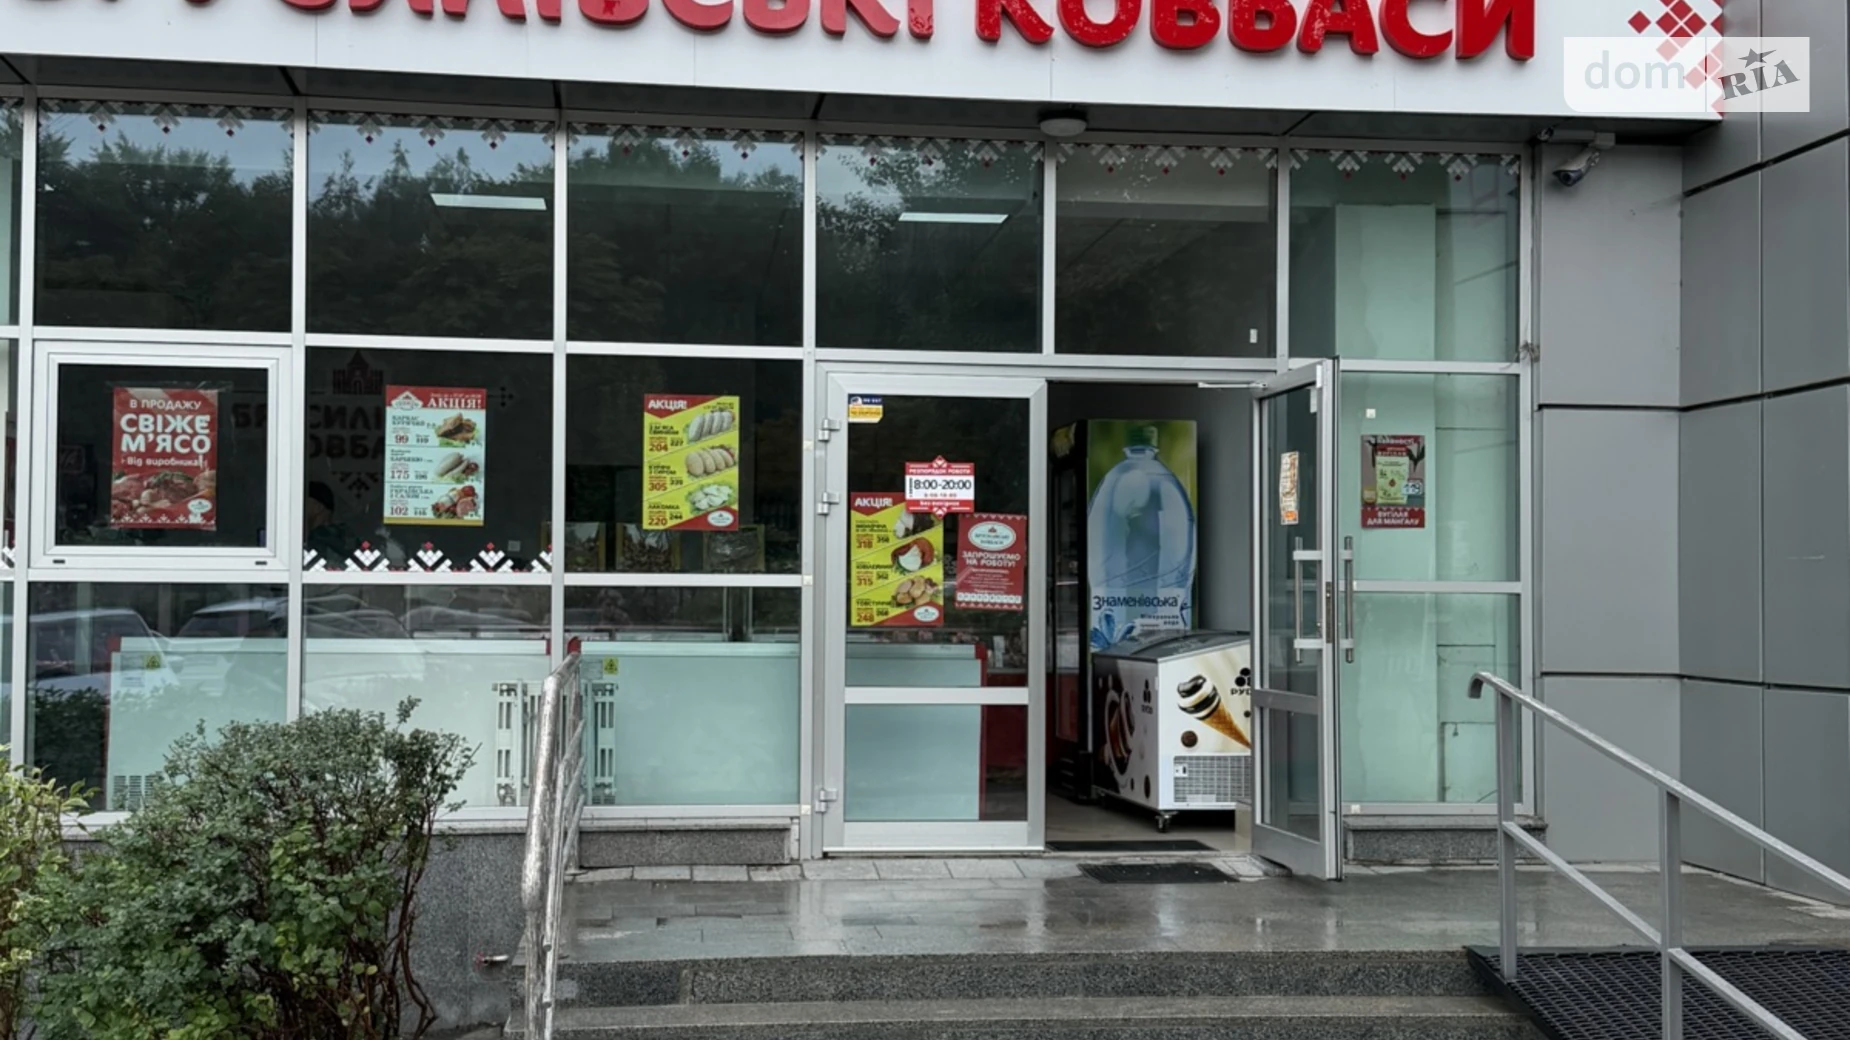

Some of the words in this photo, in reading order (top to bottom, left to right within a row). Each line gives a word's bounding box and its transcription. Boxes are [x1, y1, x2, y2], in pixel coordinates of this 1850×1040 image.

[129, 399, 137, 409] В
[141, 399, 201, 410] ПРОДАЖУ
[427, 397, 481, 409] АКЦІЯ!
[648, 399, 688, 411] АКЦІЯ!
[120, 413, 211, 434] СВІЖЕ
[120, 433, 212, 454] М’ЯСО
[394, 434, 409, 444] 99
[648, 442, 669, 452] 204
[390, 470, 410, 480] 175
[648, 482, 668, 491] 305
[913, 479, 972, 490] 8:00-20:00
[854, 497, 893, 509] АКЦІЯ!
[390, 506, 409, 516] 102
[648, 517, 668, 526] 220
[962, 550, 1021, 561] ЗАПРОШУЄМО
[965, 558, 978, 566] НА
[856, 576, 874, 586] 315
[1092, 593, 1179, 610] Знаменівська
